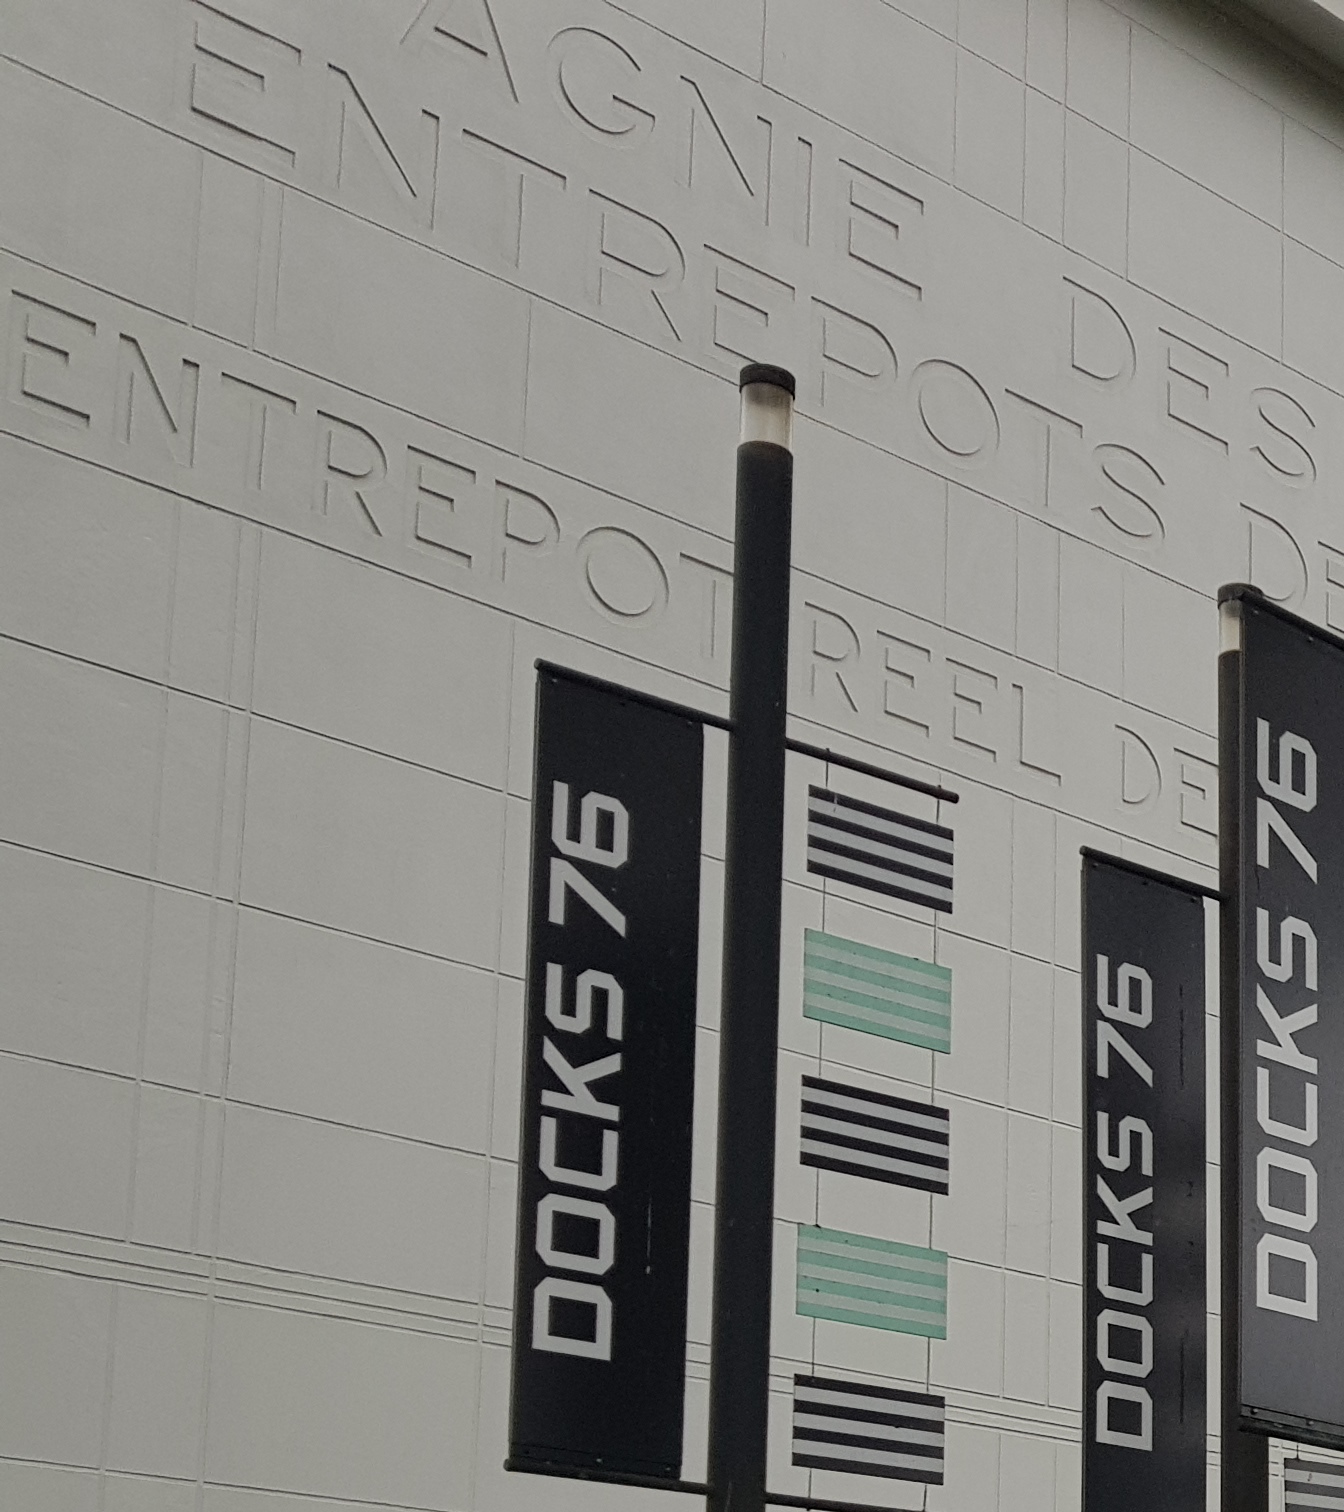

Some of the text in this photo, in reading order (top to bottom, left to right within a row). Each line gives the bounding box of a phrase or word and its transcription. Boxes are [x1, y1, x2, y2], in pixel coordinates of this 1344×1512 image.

[188, 0, 1167, 541] ENTREPOTS
[1062, 275, 1318, 484] DES
[11, 289, 736, 660] ENTREPOT
[804, 601, 1062, 788] REEL
[531, 779, 631, 1362] DOCKS 76
[1096, 953, 1154, 1452] DOCKS 76
[1256, 716, 1318, 1322] DOCKS 76
